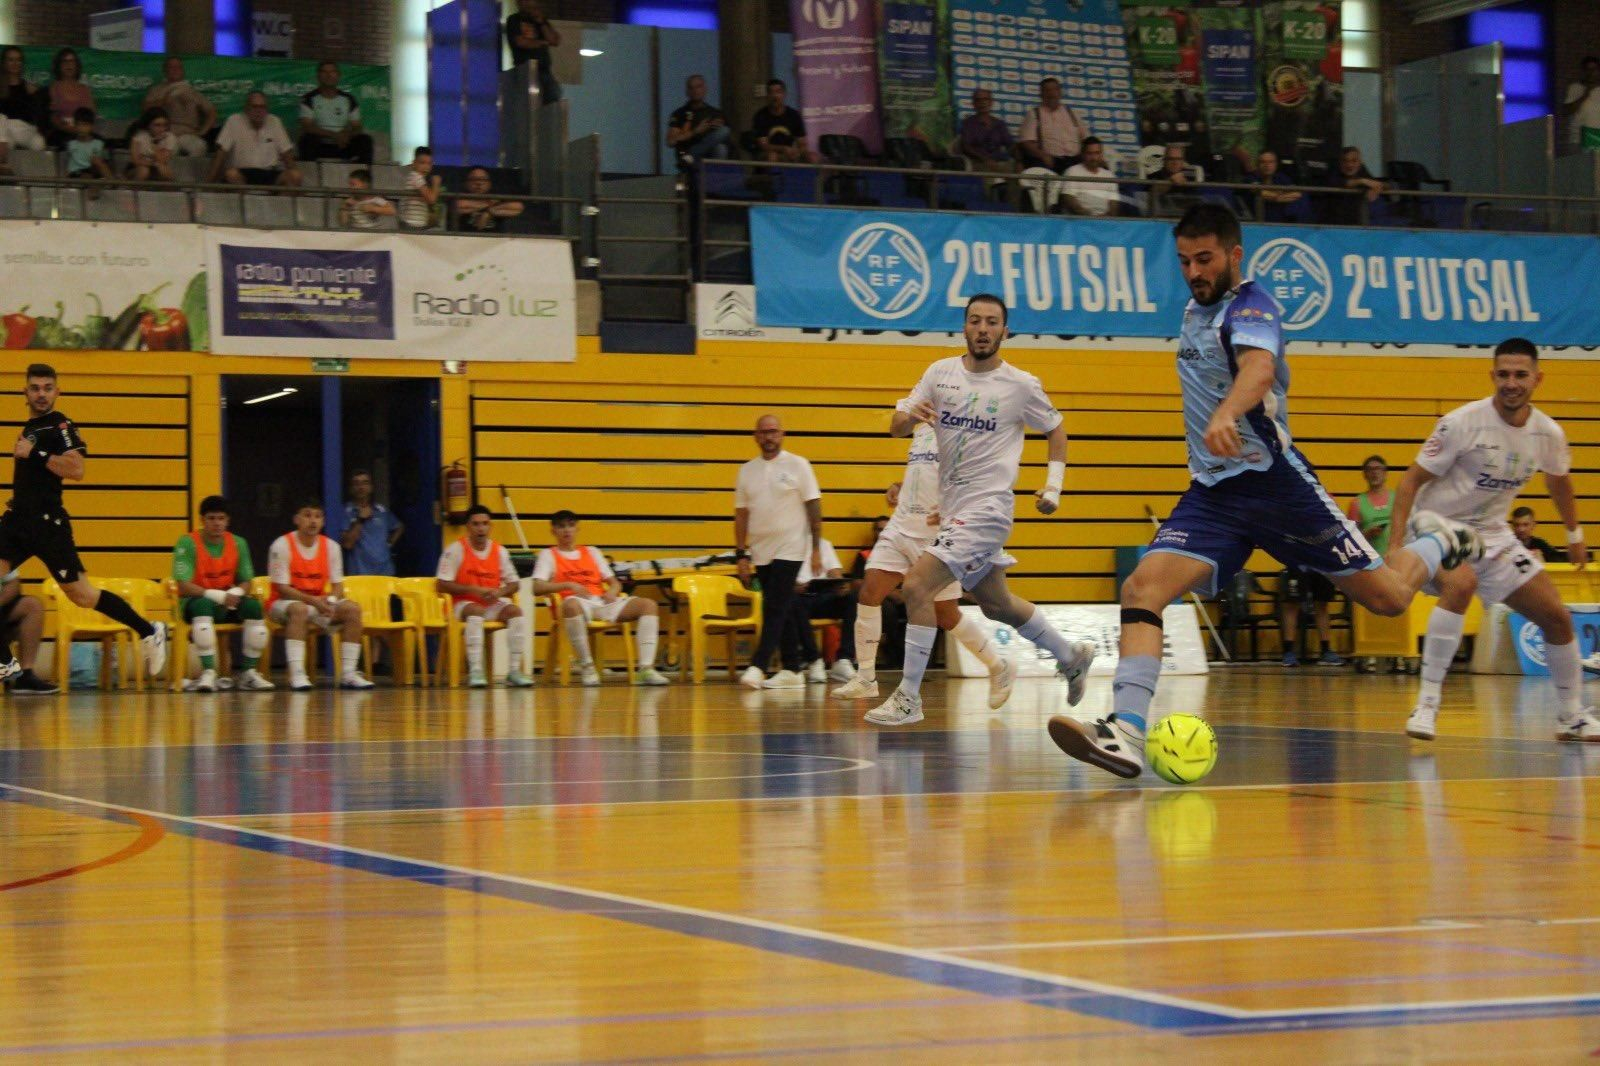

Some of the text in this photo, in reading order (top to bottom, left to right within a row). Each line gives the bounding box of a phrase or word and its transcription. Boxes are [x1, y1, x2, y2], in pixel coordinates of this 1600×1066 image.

[1001, 242, 1158, 313] FUTSAL
[1393, 256, 1541, 322] FUTSAL
[412, 291, 559, 317] Radio luz
[940, 410, 998, 432] Zambú
[1332, 537, 1364, 565] 14
